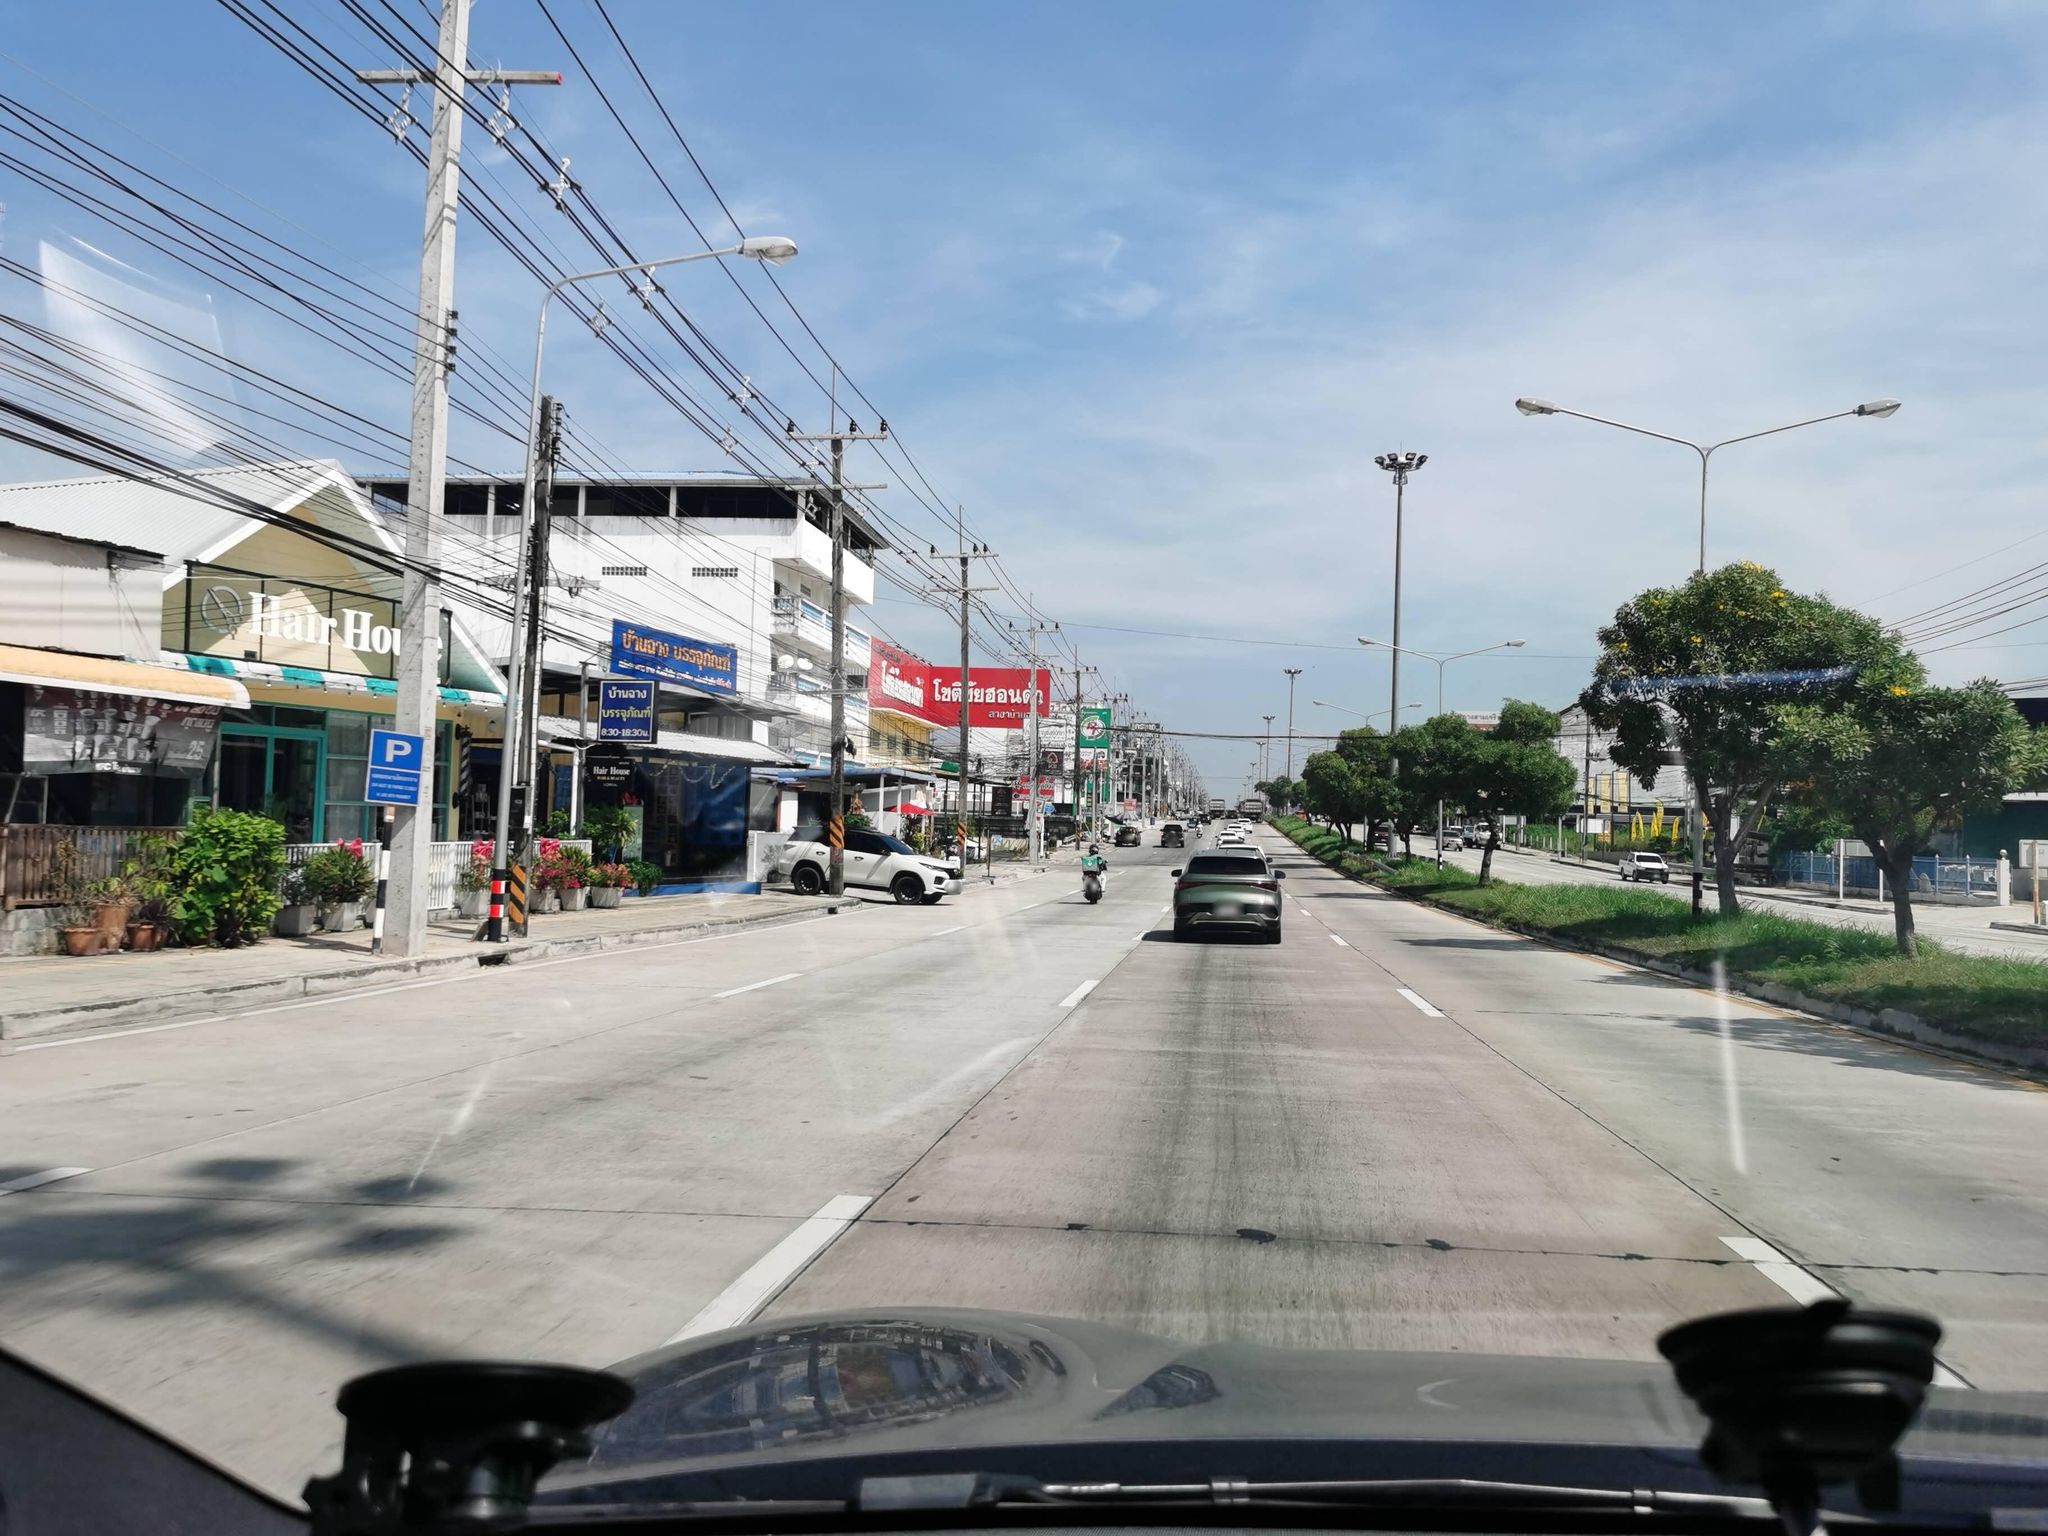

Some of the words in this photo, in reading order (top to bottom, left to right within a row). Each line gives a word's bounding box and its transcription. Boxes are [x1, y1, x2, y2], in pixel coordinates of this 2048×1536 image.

[249, 591, 337, 645] Hair
[342, 608, 442, 661] Hou
[621, 628, 669, 657] บ้านฉาง
[673, 645, 731, 672] บรรจุภัณฑ์
[608, 686, 647, 699] บ้านฉาง
[933, 678, 1043, 705] โชติัยฮอนดา
[601, 706, 651, 722] บรรจุภัณฑ์
[385, 739, 412, 763] P
[593, 766, 608, 775] Hair
[610, 766, 630, 776] House
